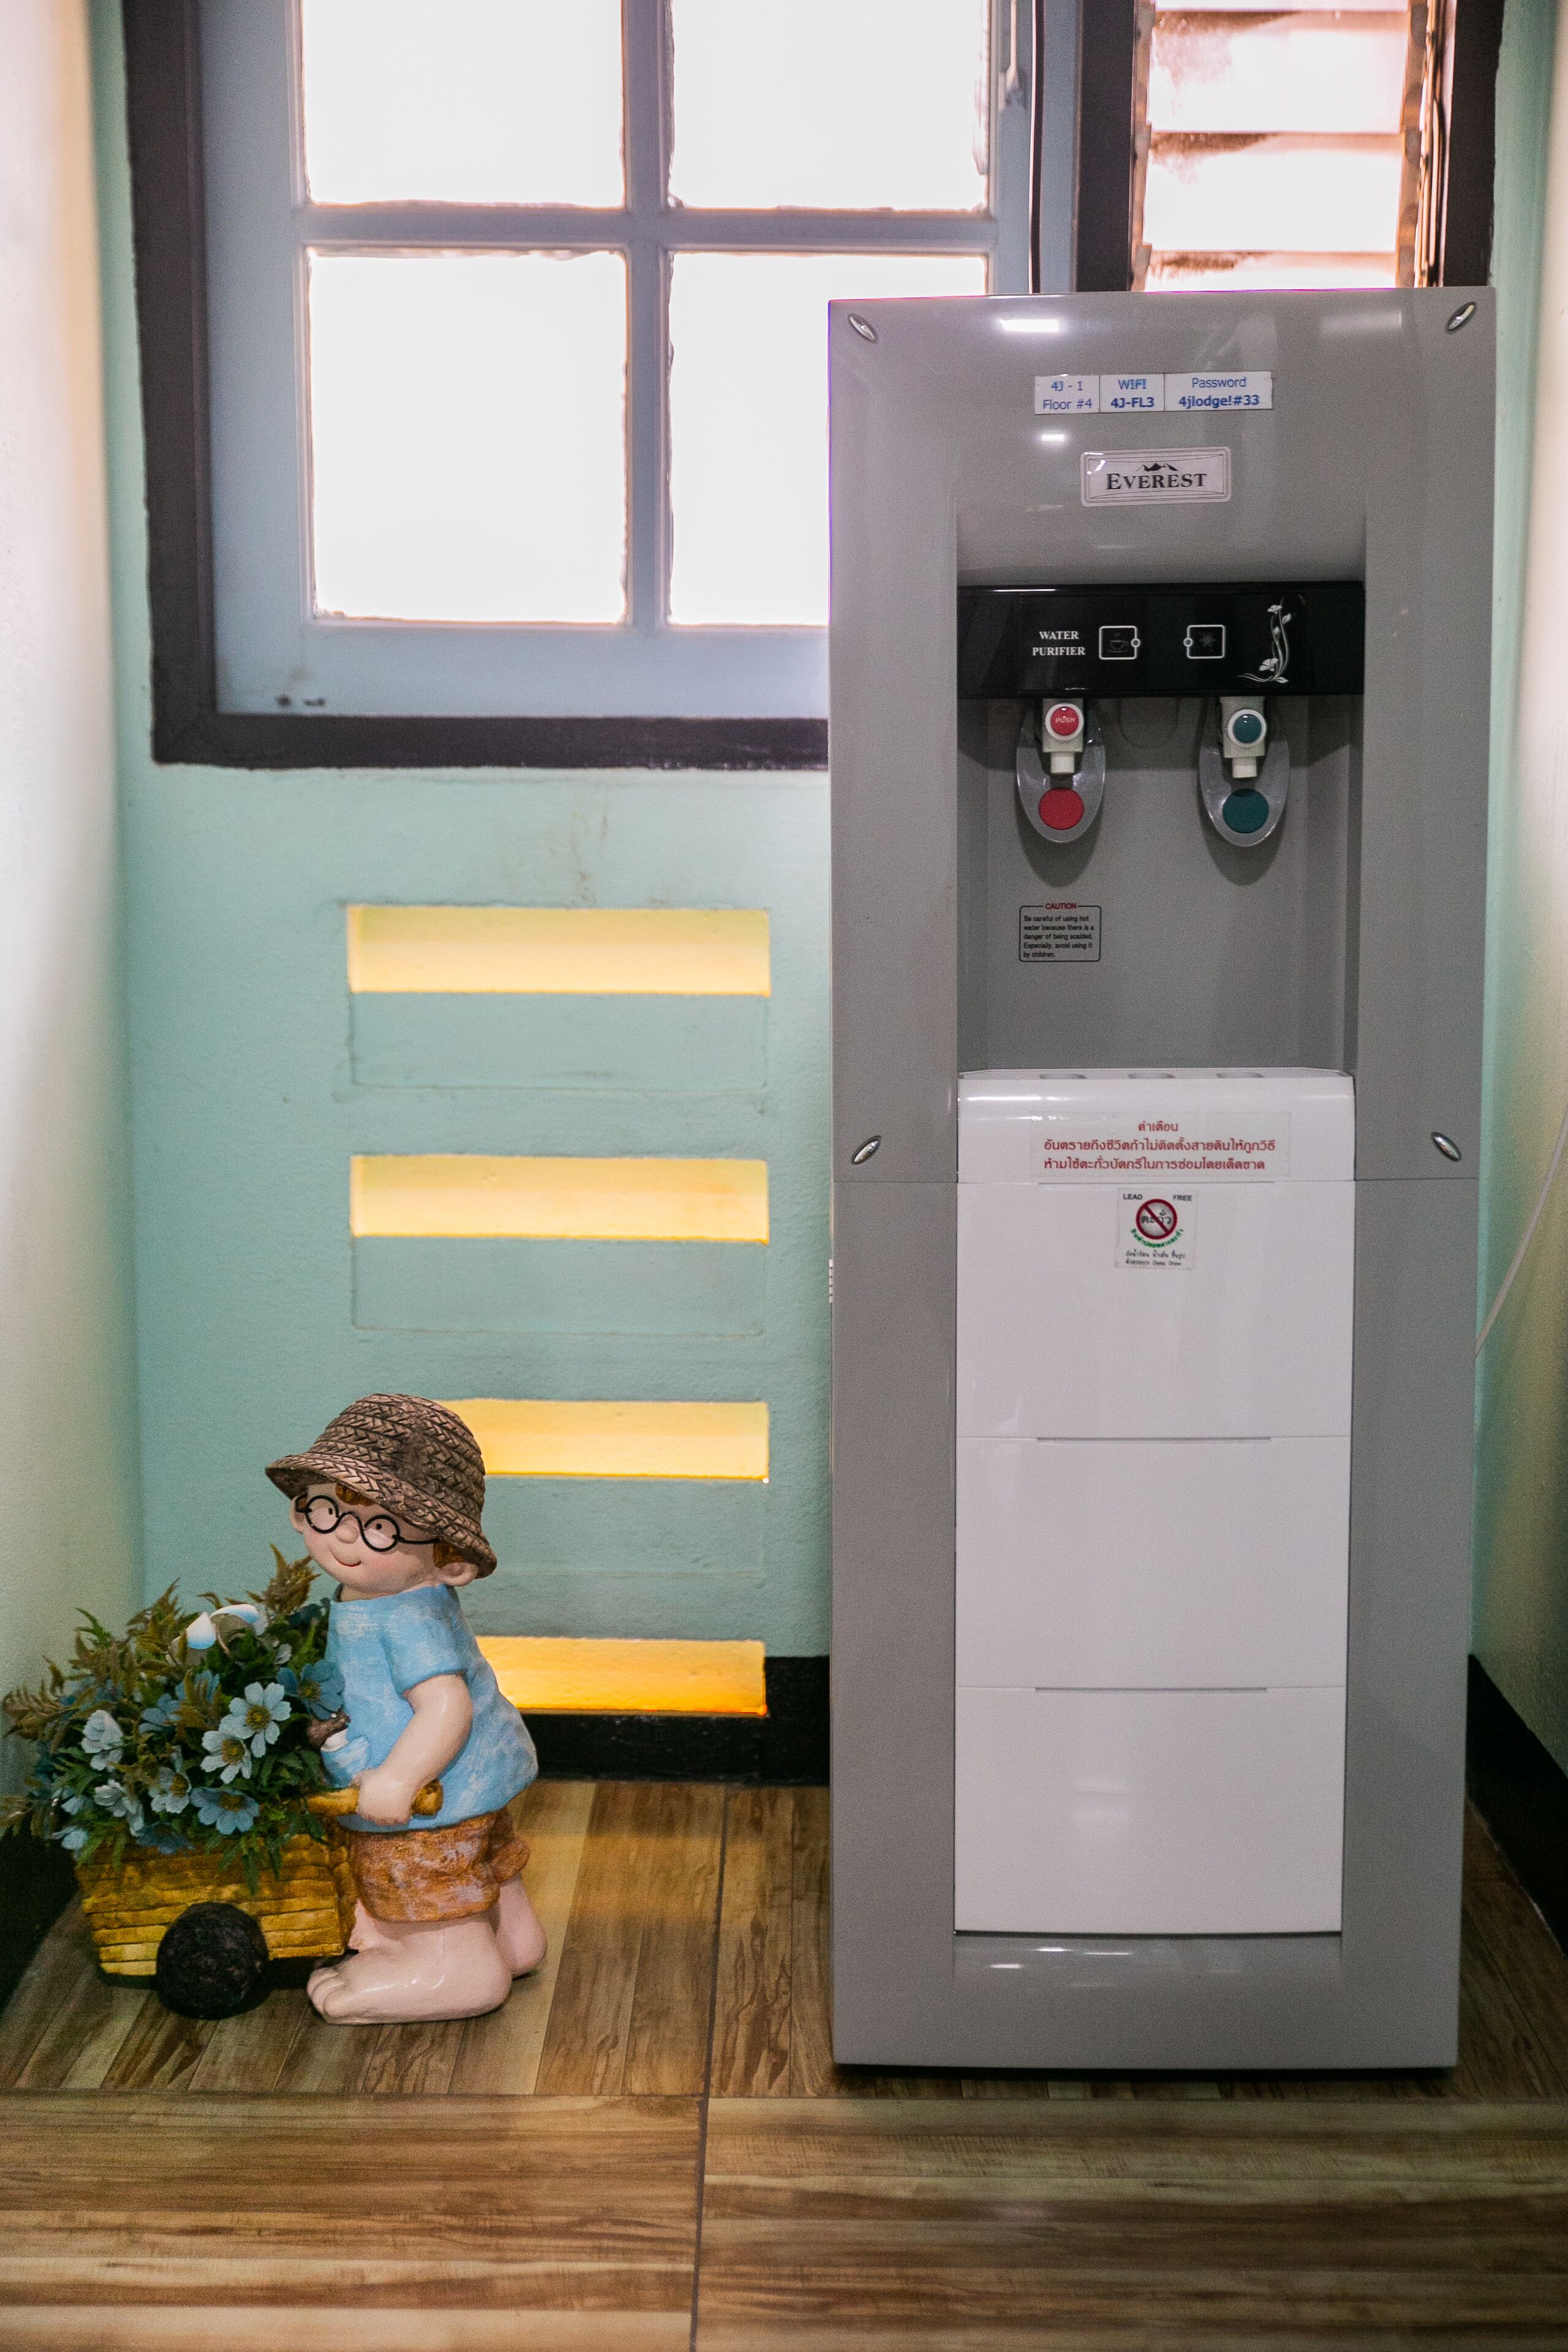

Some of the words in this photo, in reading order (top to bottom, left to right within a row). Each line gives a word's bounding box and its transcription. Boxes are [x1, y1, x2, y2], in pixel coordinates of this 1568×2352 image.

[1050, 381, 1063, 391] 4J
[1077, 380, 1083, 391] 1
[1118, 379, 1147, 390] WIFI
[1192, 377, 1246, 388] Password
[1042, 399, 1072, 410] Floor
[1077, 398, 1093, 409] #4
[1110, 397, 1155, 409] 4J-FL3
[1178, 394, 1260, 409] 4jlodge!#33
[1039, 631, 1079, 640] WATER
[1032, 647, 1086, 656] PURIFIER
[1138, 1120, 1179, 1132] คำเตือน
